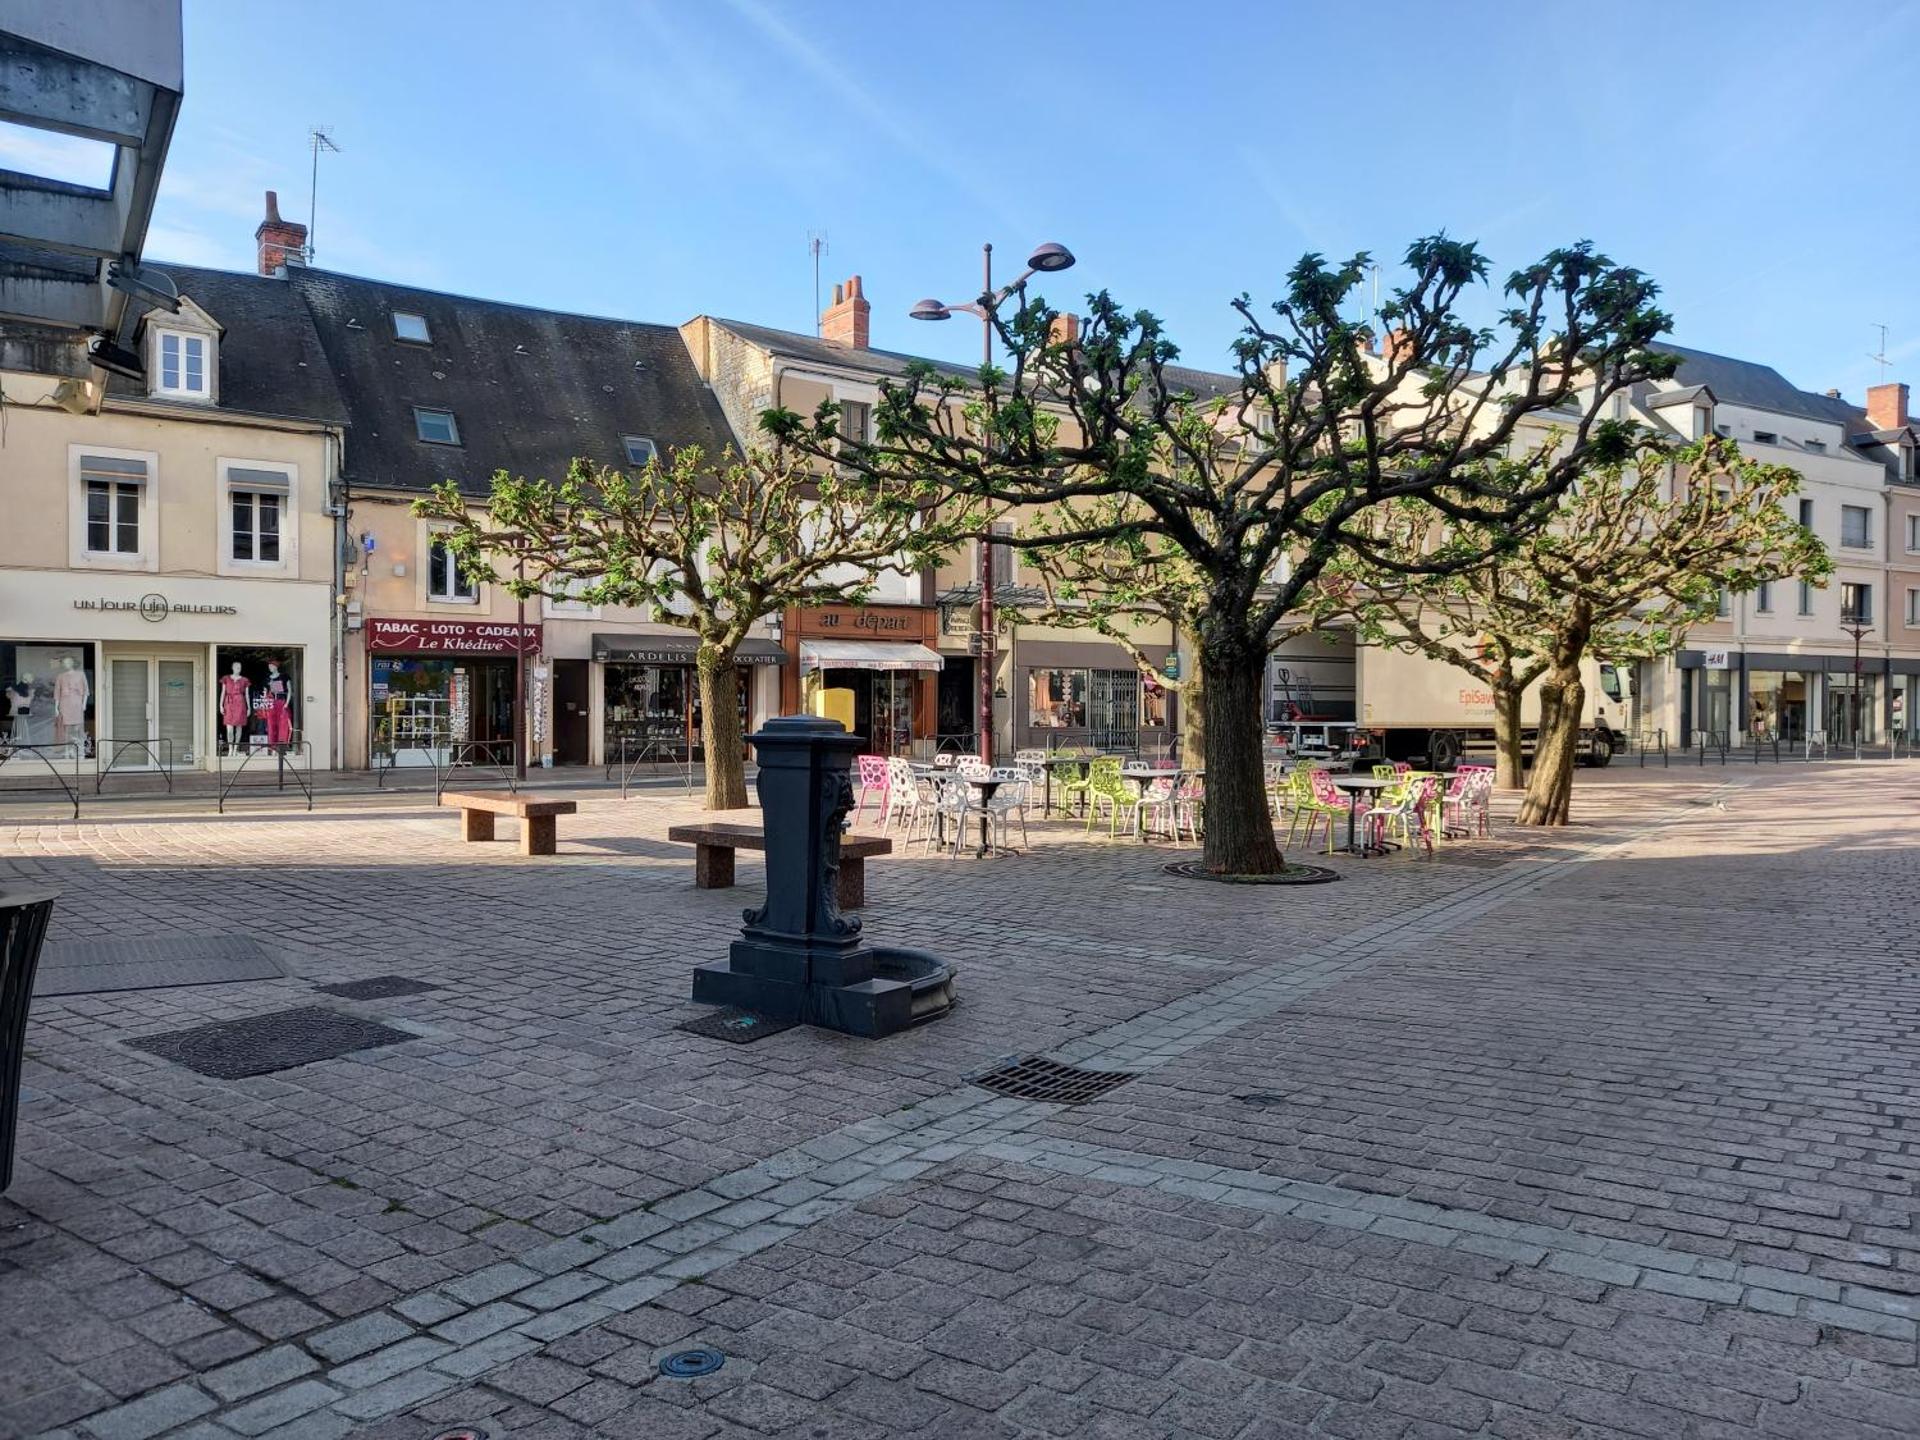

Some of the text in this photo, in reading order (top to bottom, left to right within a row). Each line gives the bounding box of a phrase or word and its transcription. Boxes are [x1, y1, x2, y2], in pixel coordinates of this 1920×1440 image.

[73, 600, 96, 609] UN
[173, 603, 238, 615] AILLEURS
[375, 622, 419, 634] TABAC
[431, 624, 466, 635] LOTO
[820, 610, 910, 634] au départ
[418, 637, 504, 651] Le Khédive
[628, 652, 687, 661] ARDELIS
[252, 702, 275, 710] DAYS
